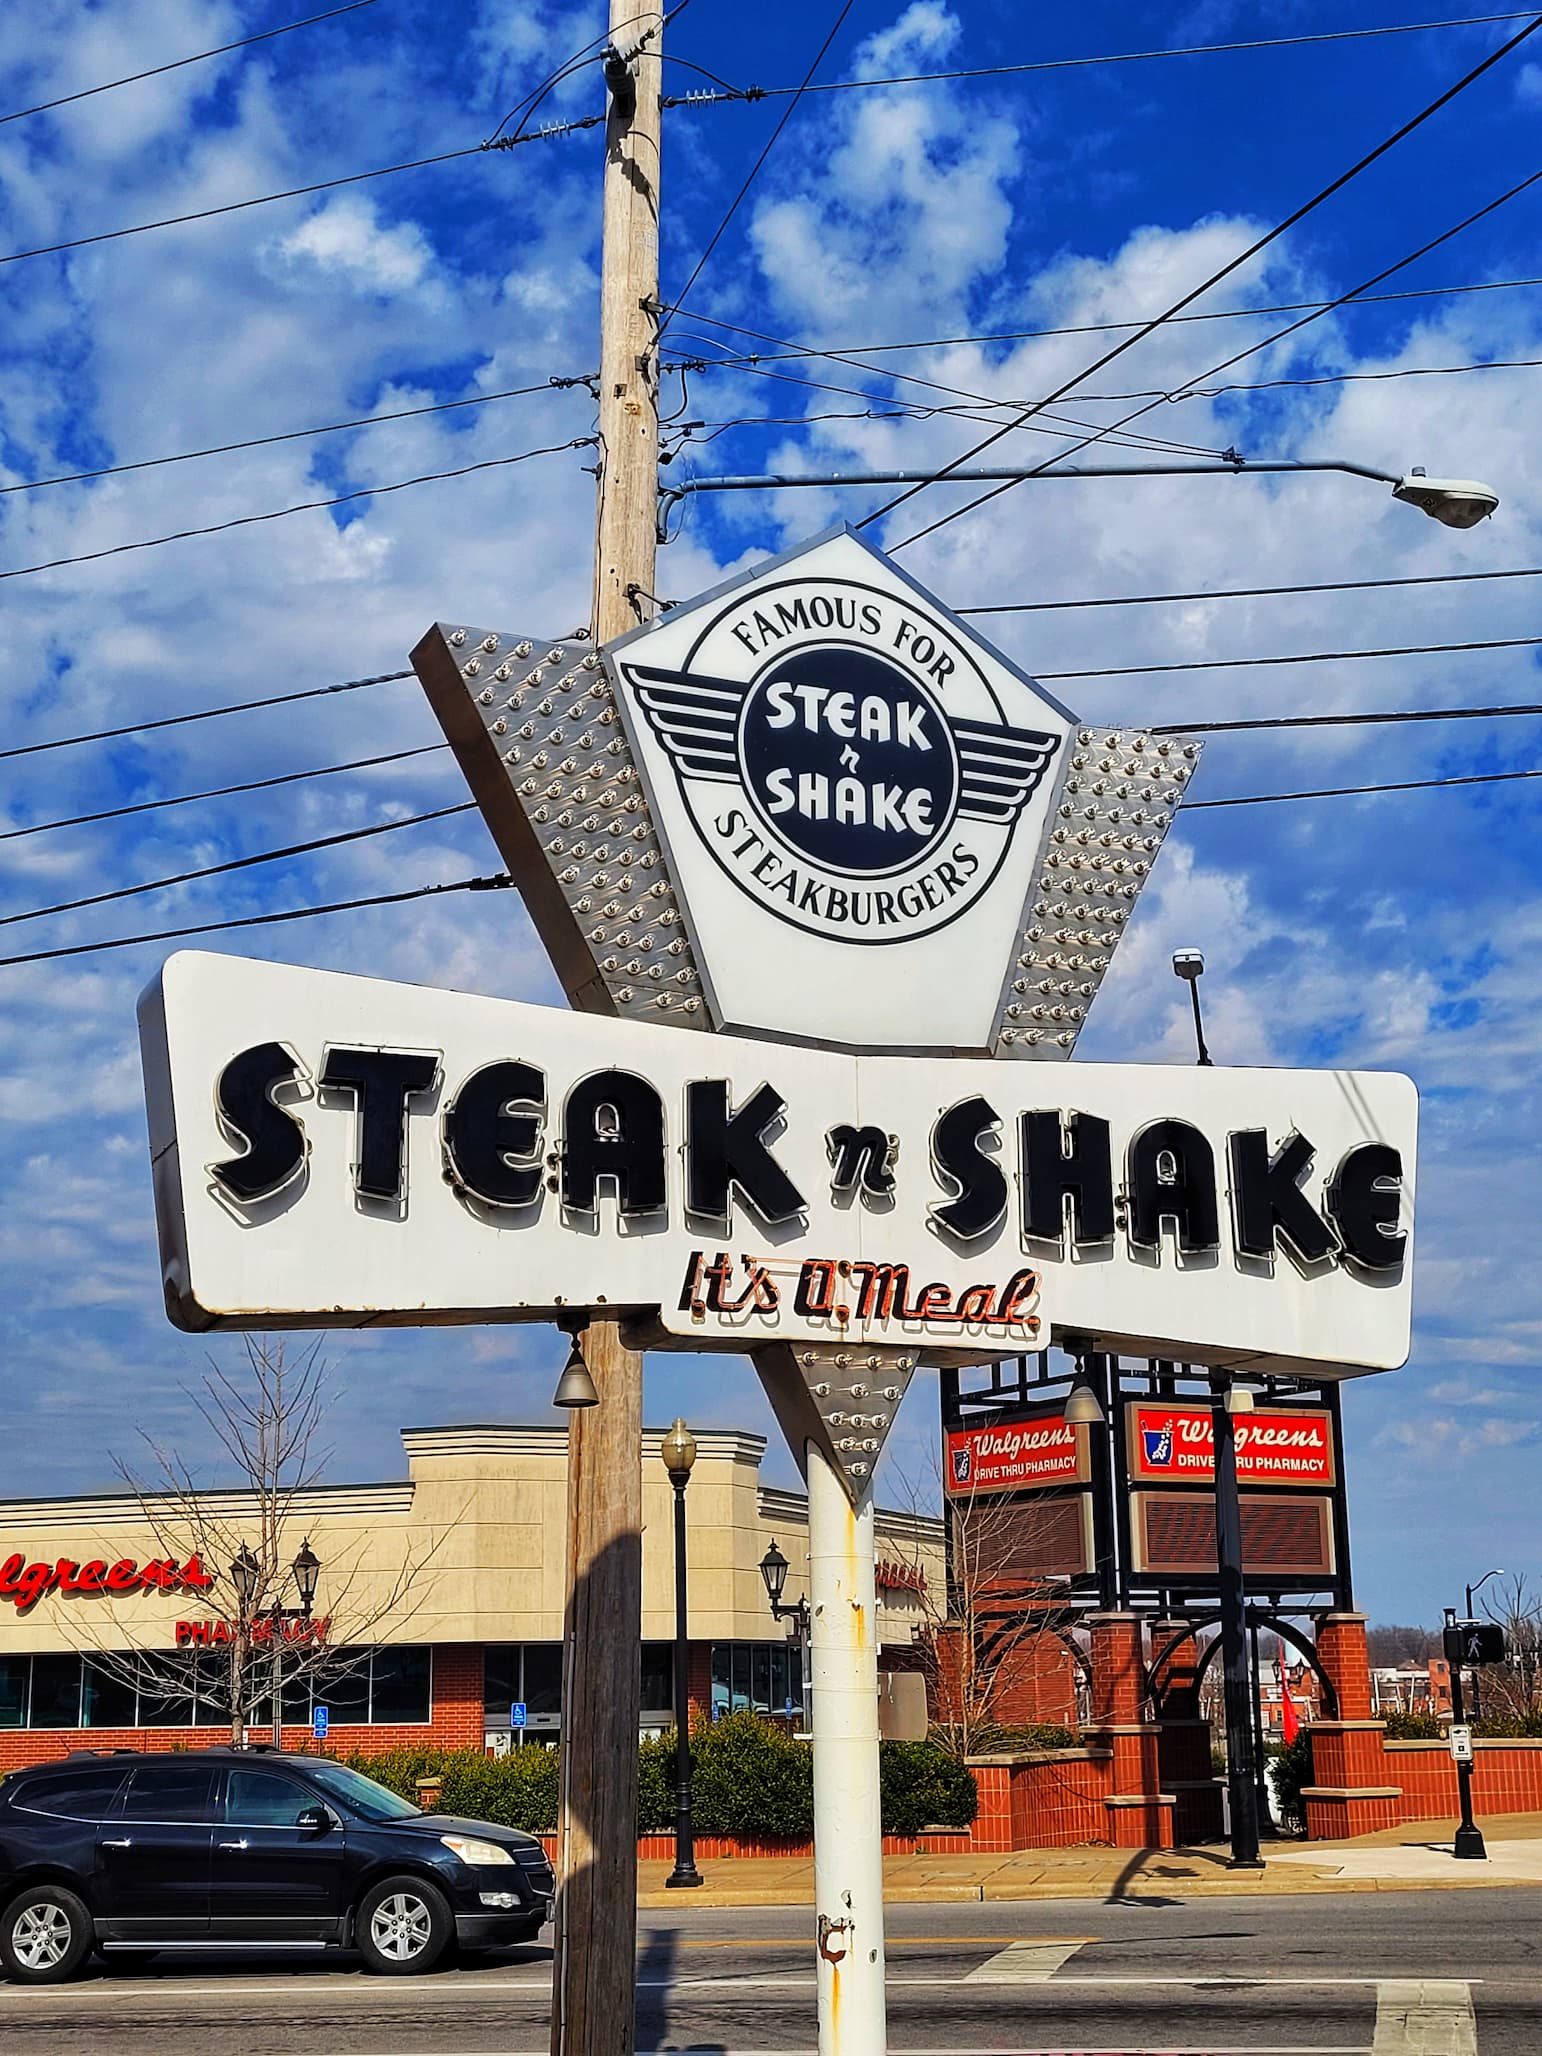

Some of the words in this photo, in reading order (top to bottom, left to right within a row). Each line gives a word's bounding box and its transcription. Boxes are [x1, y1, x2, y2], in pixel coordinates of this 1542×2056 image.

[731, 597, 882, 656] FAMOUS
[893, 618, 955, 690] FOR
[764, 681, 932, 751] STEAK
[764, 767, 935, 836] SHAKE
[714, 809, 980, 926] STEAKBURGERS
[205, 1041, 808, 1213] STEAK
[825, 1122, 901, 1195] n
[928, 1094, 1408, 1272] SHAKE
[973, 1424, 1076, 1461] Walgreens
[974, 1466, 1000, 1480] DRIVE
[1001, 1462, 1025, 1477] THRU
[1026, 1455, 1077, 1475] PHARMACY
[1177, 1418, 1324, 1453] Wgreens
[1178, 1454, 1215, 1468] DRIVE
[1256, 1457, 1325, 1471] PHARMACY
